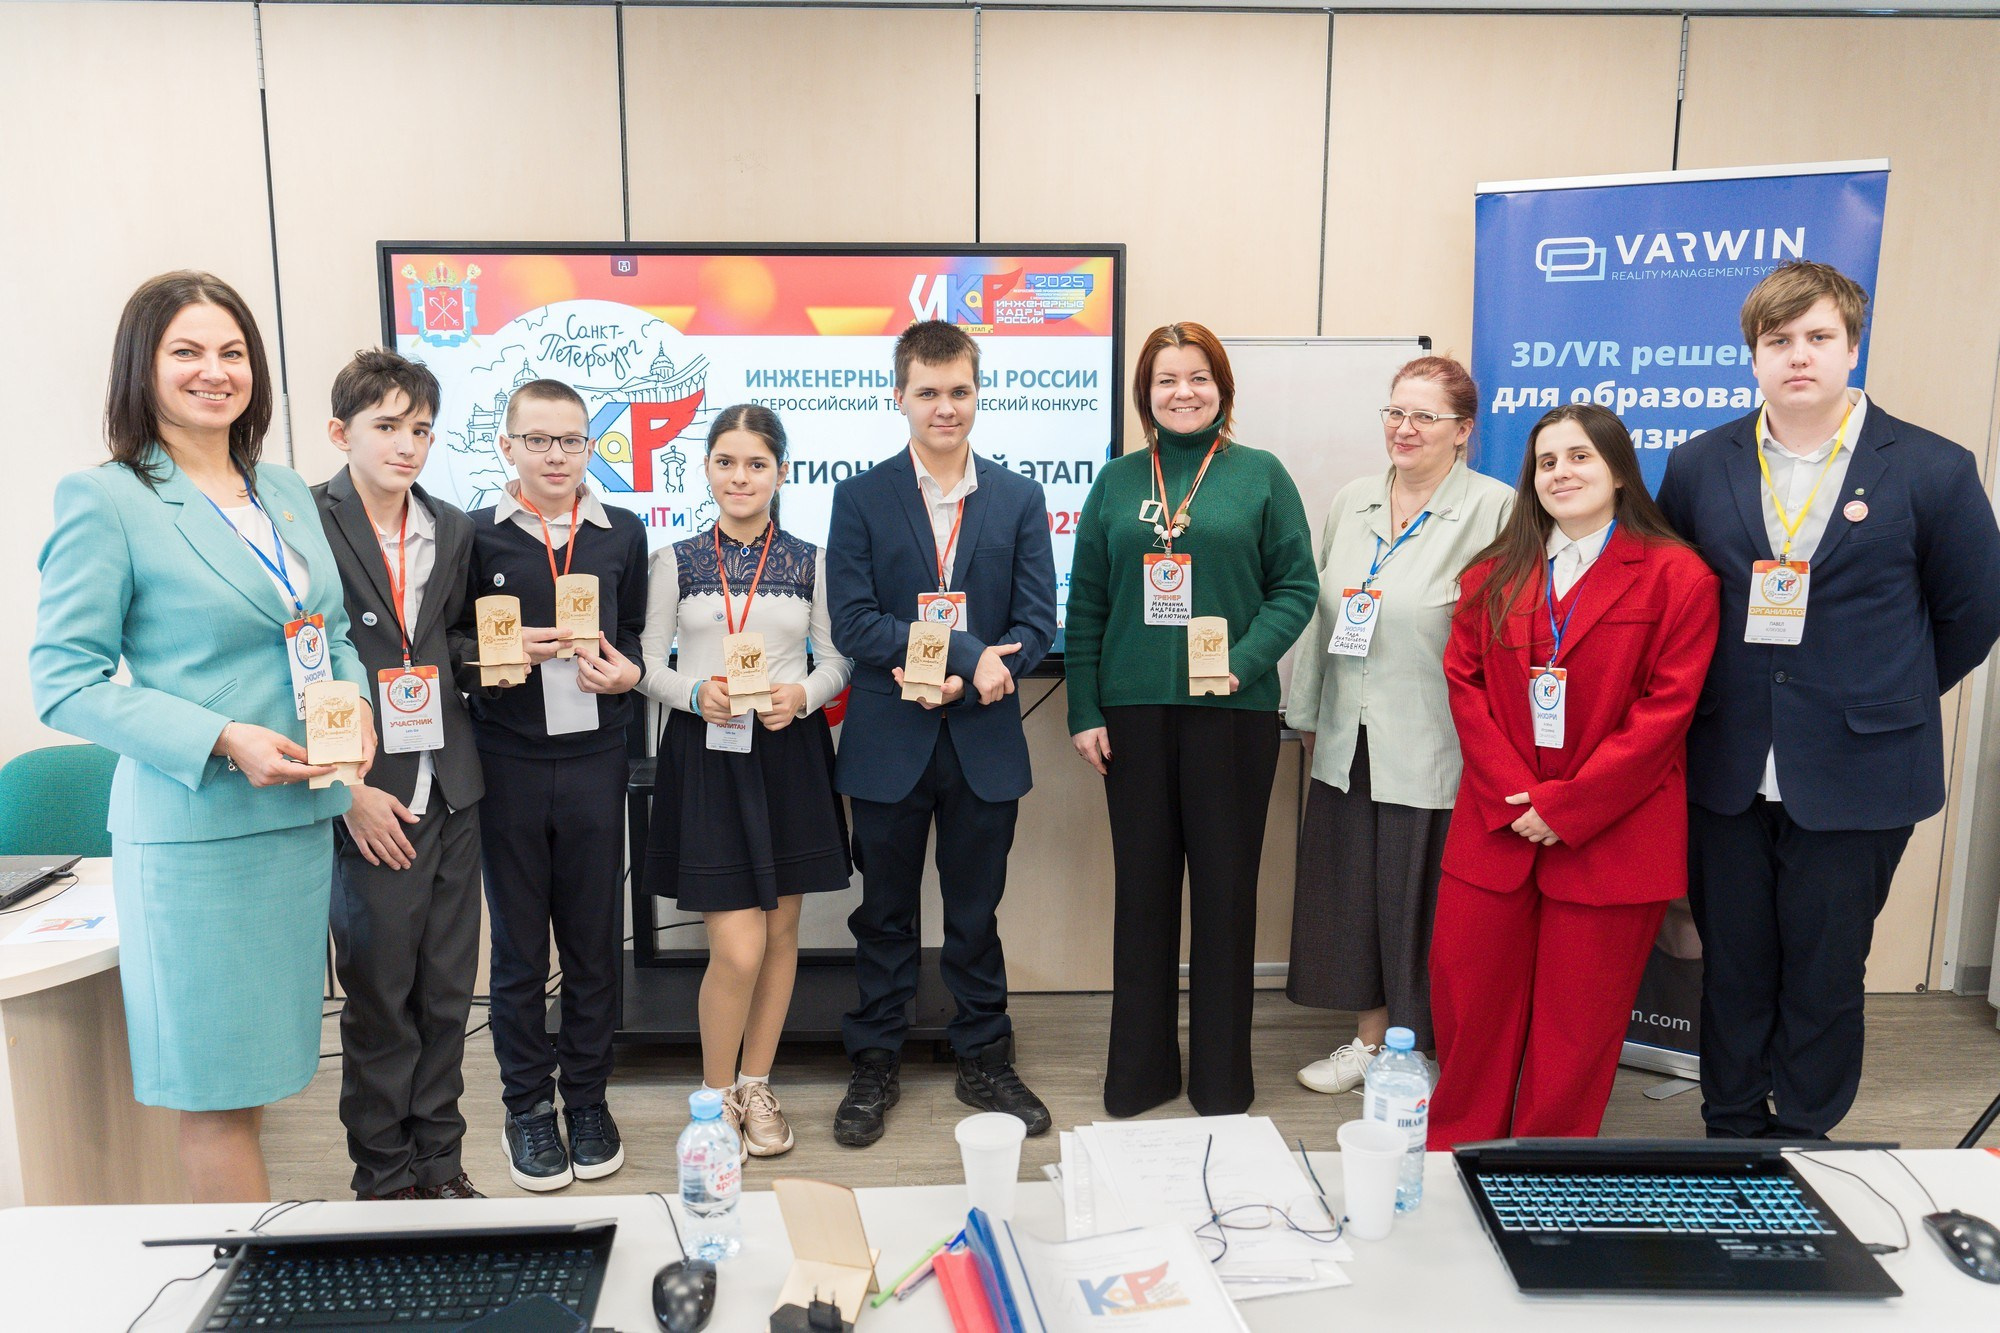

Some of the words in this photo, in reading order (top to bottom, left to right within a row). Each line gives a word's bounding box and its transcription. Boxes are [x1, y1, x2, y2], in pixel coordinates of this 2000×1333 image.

[1615, 227, 1805, 265] VARWIN
[1035, 275, 1084, 288] 2025
[1611, 270, 1659, 281] REALITY
[1660, 266, 1752, 279] MANAGEMENT
[996, 300, 1084, 308] ИНЖЕНЕРНЫЕ
[996, 309, 1044, 317] КАДРЫ
[566, 313, 625, 341] Санкт-
[536, 333, 643, 380] Петербург
[1511, 341, 1621, 368] 3D/VR
[745, 369, 896, 388] ИНЖЕНЕРНЫ
[1005, 369, 1098, 388] РОССИИ
[1031, 399, 1098, 411] КОНКУРС
[1491, 387, 1560, 414] для
[1019, 460, 1093, 484] ЭТАП
[390, 718, 433, 728] УЧАСТНИК
[1631, 1009, 1691, 1032] n.com
